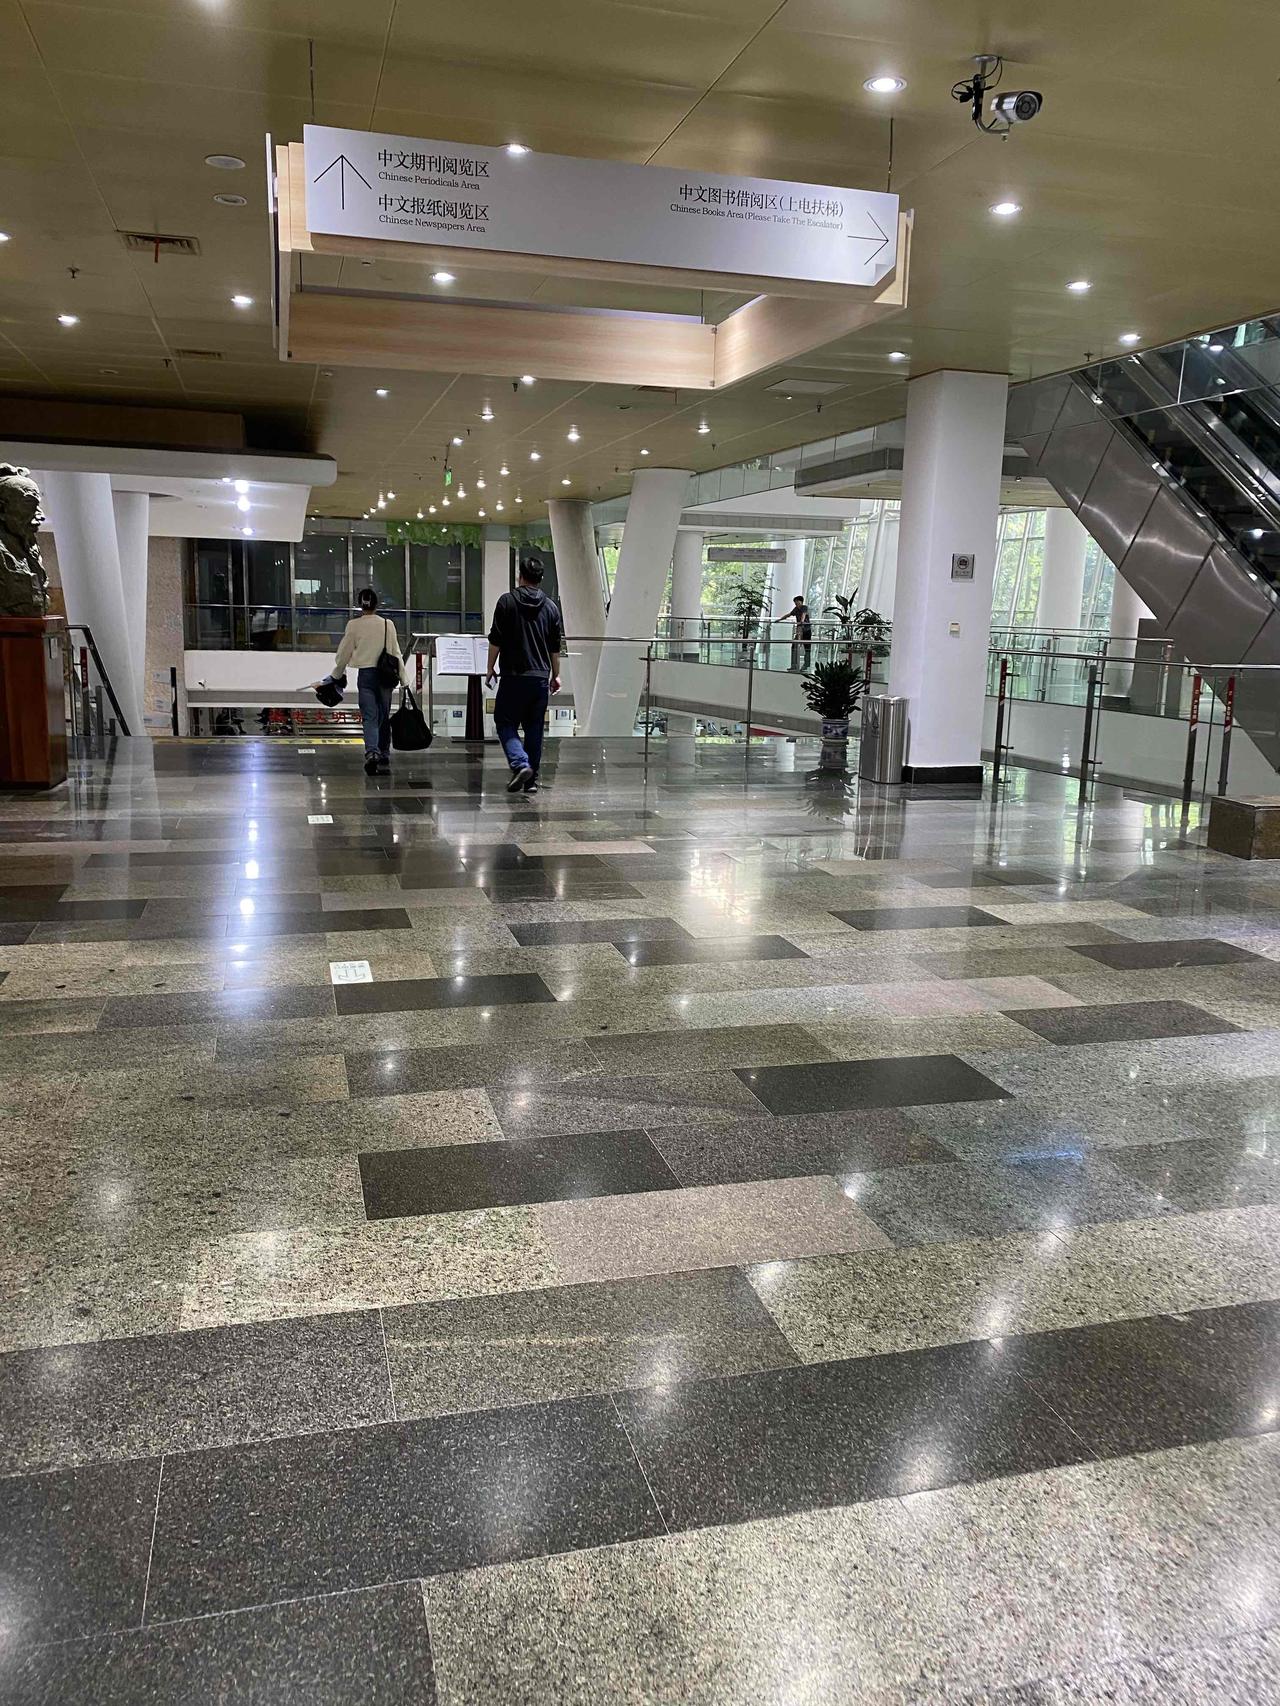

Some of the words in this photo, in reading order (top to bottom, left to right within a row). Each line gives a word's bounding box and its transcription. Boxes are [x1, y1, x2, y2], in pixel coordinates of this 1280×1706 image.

[378, 149, 490, 178] 中文期刊阅览区
[378, 171, 414, 183] Chinese
[415, 175, 459, 188] Periodicals
[460, 180, 480, 190] Area
[379, 194, 490, 221] 中文报纸阅览区
[670, 203, 701, 215] Chinese
[702, 207, 726, 217] Books
[773, 215, 791, 224] Take
[792, 217, 806, 225] The
[379, 214, 414, 226] Chinese
[415, 218, 465, 231] Newspapers
[466, 223, 486, 233] Area
